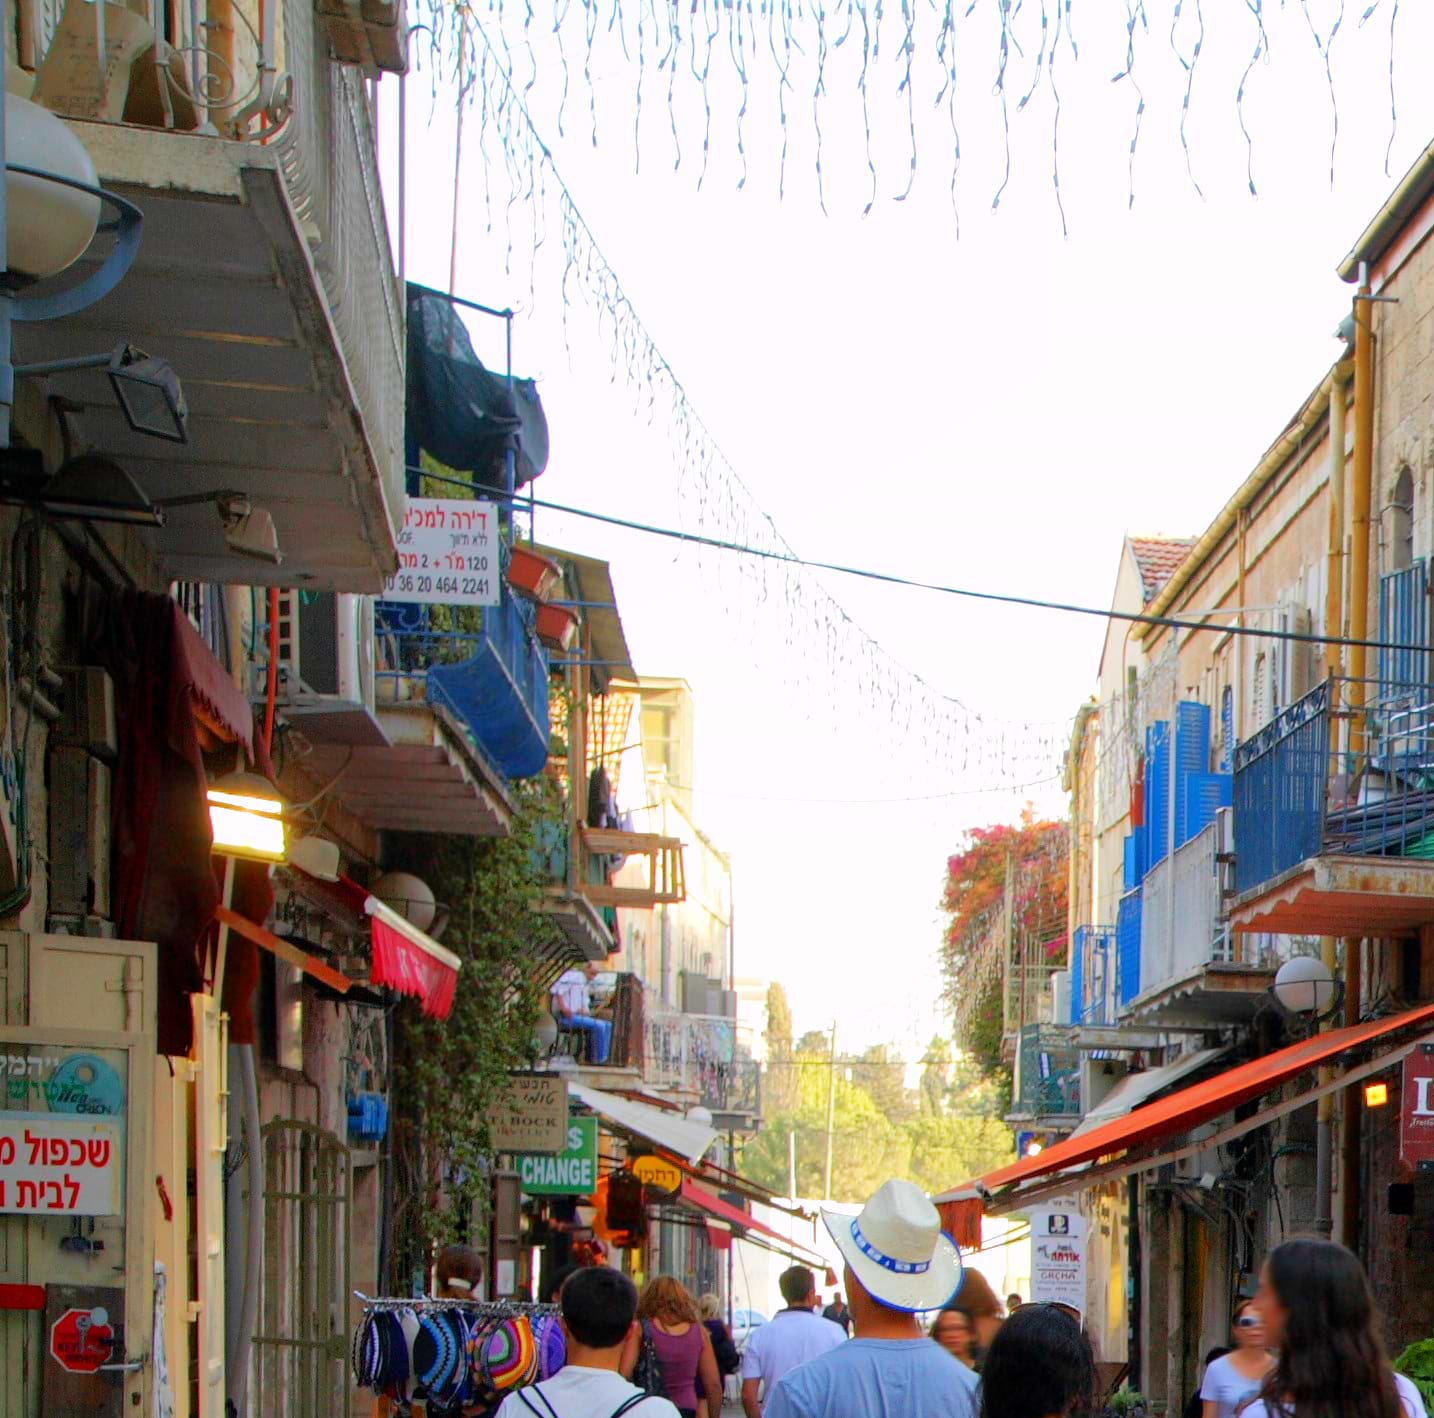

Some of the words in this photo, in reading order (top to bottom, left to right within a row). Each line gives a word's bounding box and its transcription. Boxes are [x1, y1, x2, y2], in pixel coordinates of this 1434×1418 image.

[451, 510, 487, 529] דירה
[421, 554, 429, 568] 2
[467, 556, 488, 571] 120
[399, 575, 413, 592] 36
[418, 576, 432, 592] 20
[436, 577, 458, 593] 464
[462, 578, 490, 595] 2241
[24, 1129, 110, 1168] שכפול
[521, 1157, 591, 1186] CHANGE
[16, 1174, 80, 1209] לבית
